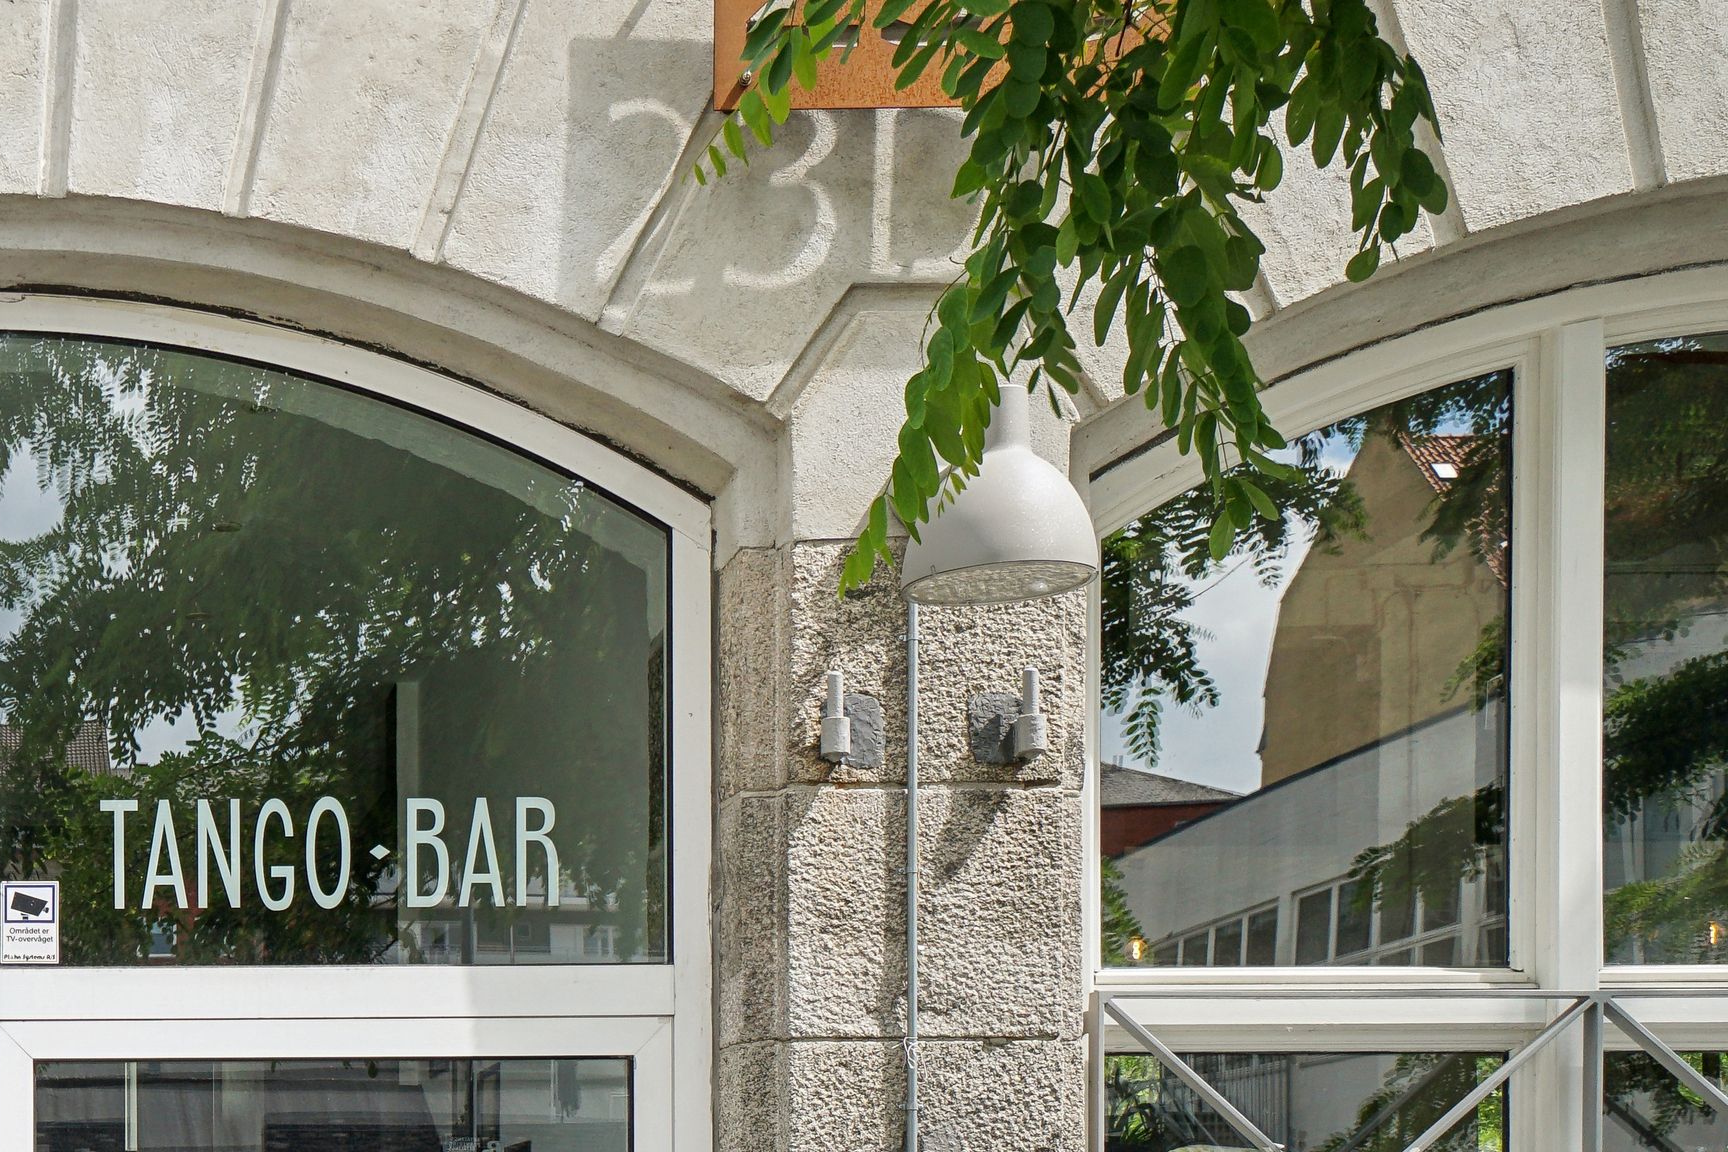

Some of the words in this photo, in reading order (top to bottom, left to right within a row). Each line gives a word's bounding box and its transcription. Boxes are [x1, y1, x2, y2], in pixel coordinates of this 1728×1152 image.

[100, 796, 352, 911] TANGO
[407, 797, 560, 908] BAR
[6, 935, 53, 944] TV-overvåget
